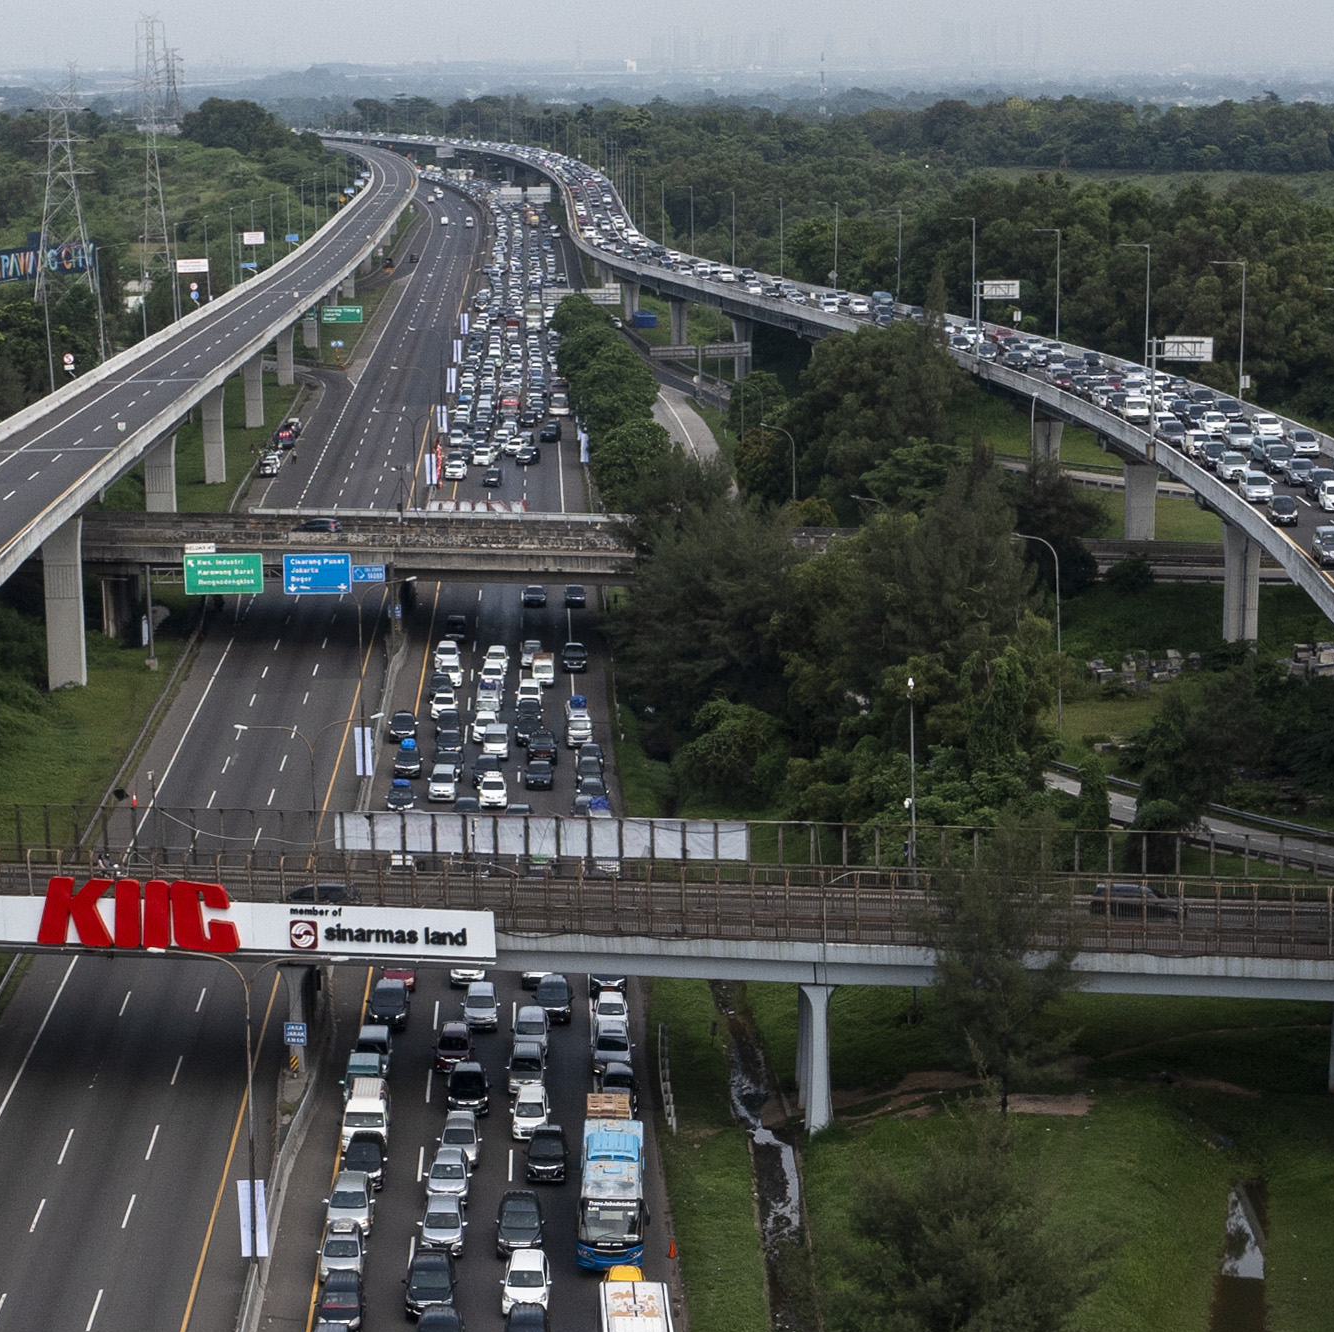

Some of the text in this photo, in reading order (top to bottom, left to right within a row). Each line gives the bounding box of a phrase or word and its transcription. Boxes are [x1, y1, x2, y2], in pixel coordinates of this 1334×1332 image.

[37, 876, 240, 953] KIIC
[289, 907, 343, 918] member of
[324, 925, 467, 946] sinarmas land
